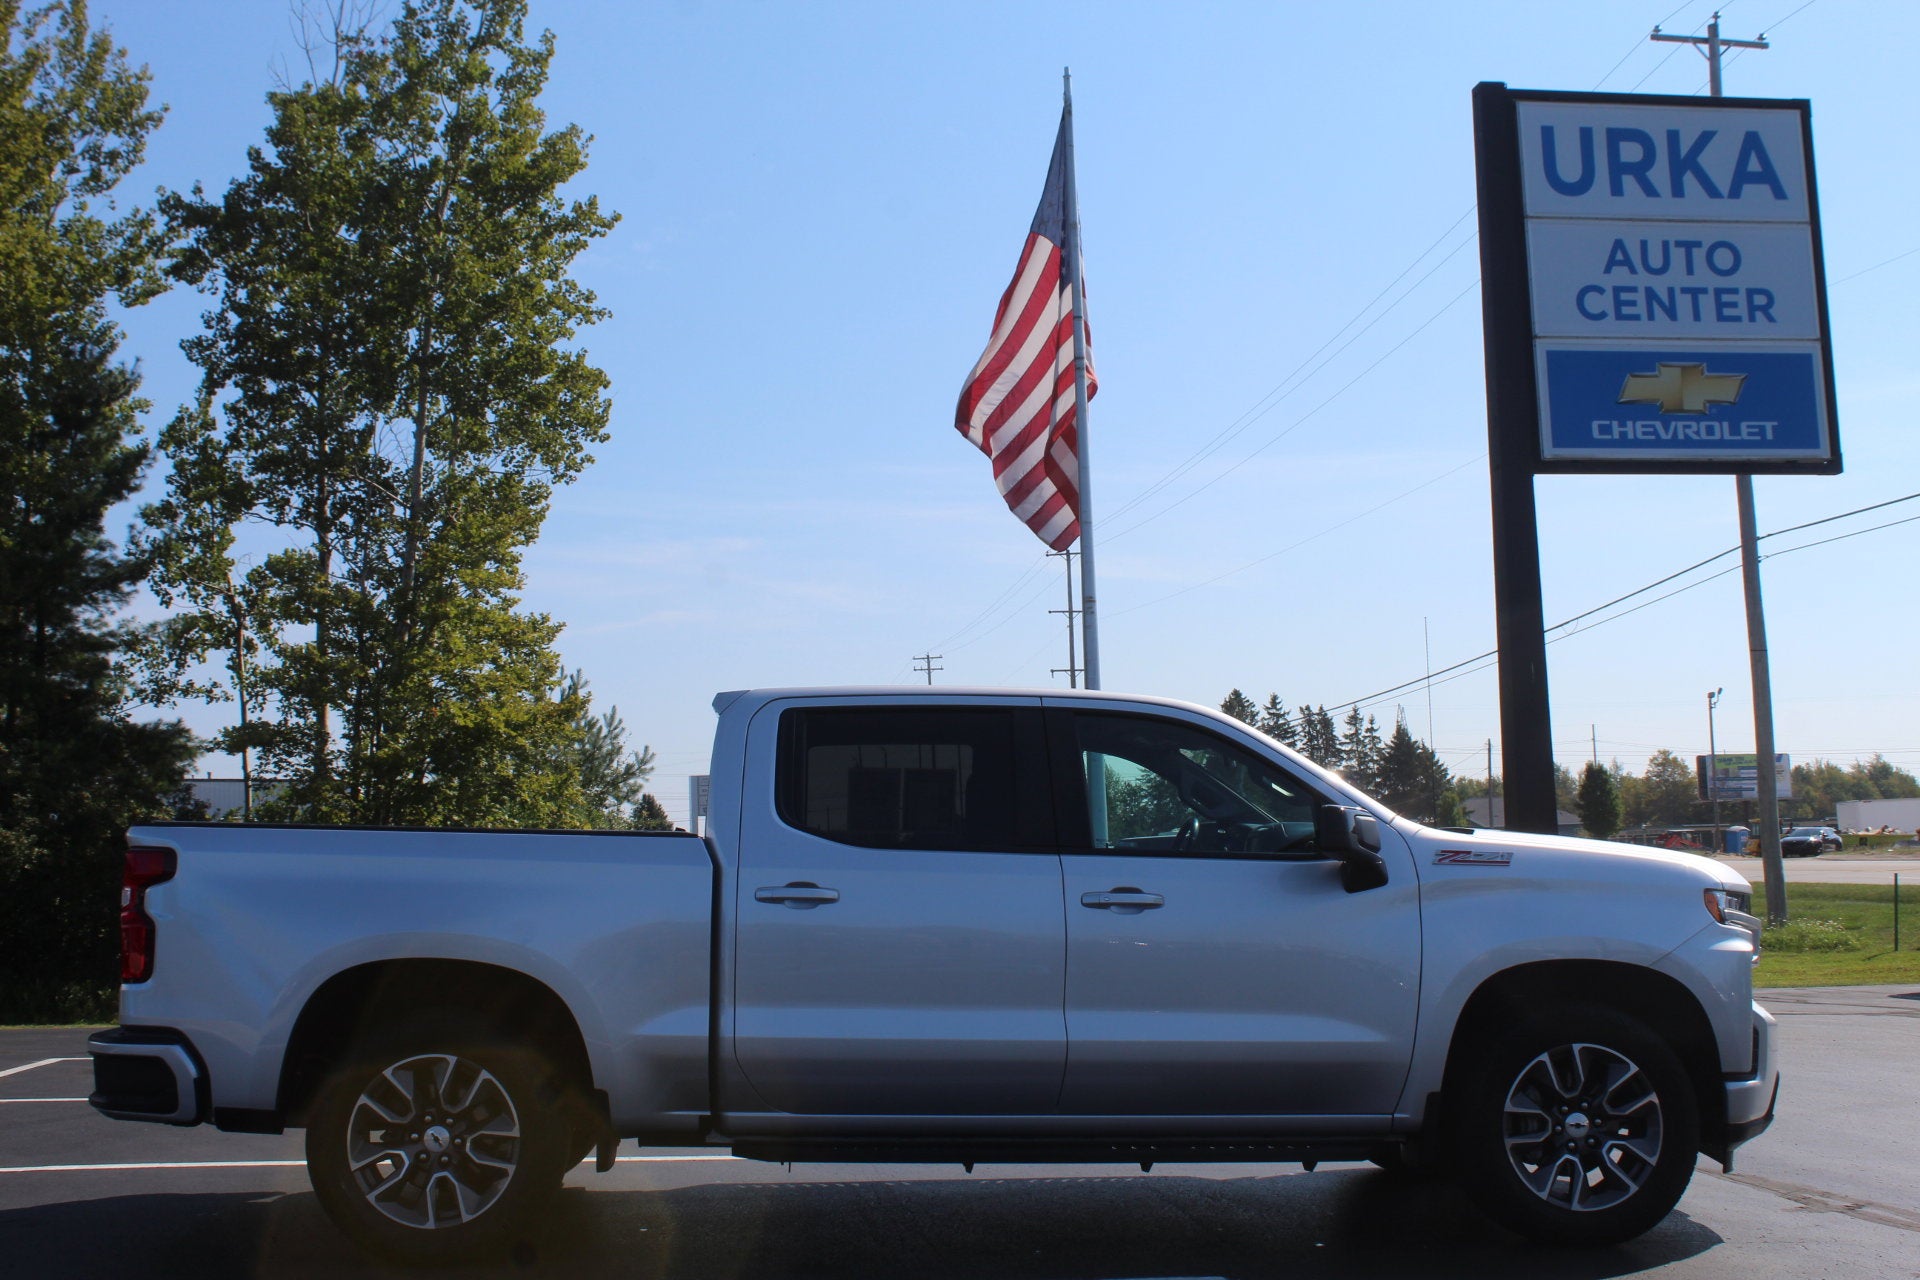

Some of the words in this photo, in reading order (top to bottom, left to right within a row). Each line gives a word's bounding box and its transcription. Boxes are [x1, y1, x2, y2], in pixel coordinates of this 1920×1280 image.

[1541, 126, 1788, 200] URKA
[1603, 238, 1742, 276] AUTO
[1575, 284, 1777, 323] CENTER
[1592, 420, 1778, 440] CHEVROLET
[1432, 849, 1514, 866] Z71
